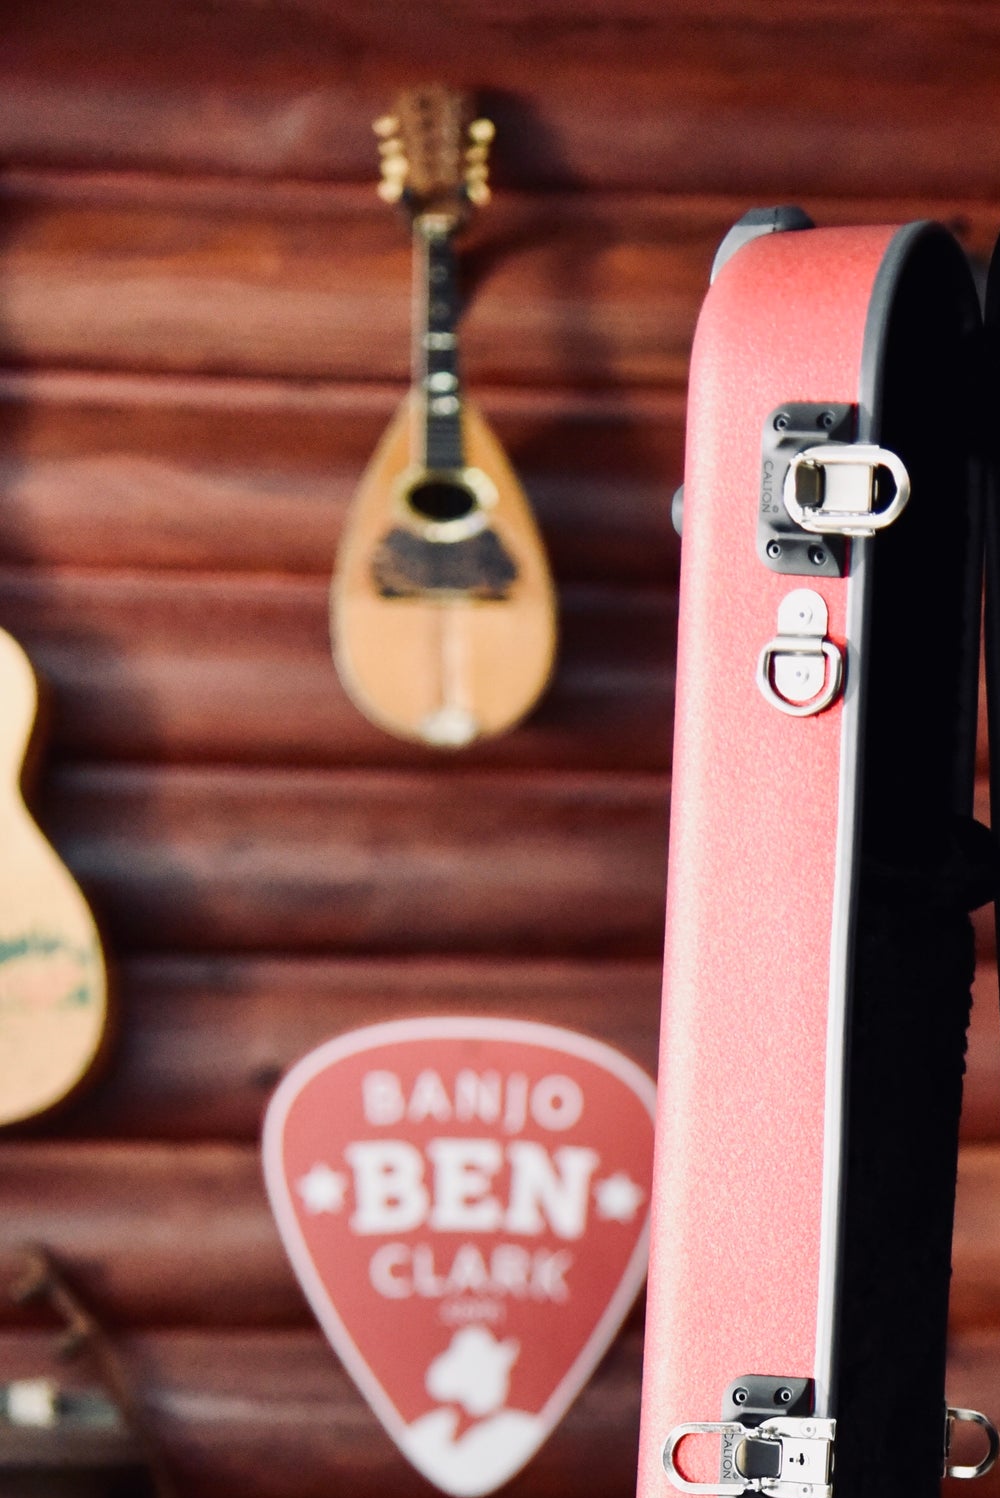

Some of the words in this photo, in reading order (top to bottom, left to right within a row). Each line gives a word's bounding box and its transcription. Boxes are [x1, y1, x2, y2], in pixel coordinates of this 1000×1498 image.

[761, 460, 774, 513] CALTON
[362, 1069, 585, 1133] BANJO
[344, 1137, 600, 1240] BEN
[369, 1243, 574, 1302] CLARK
